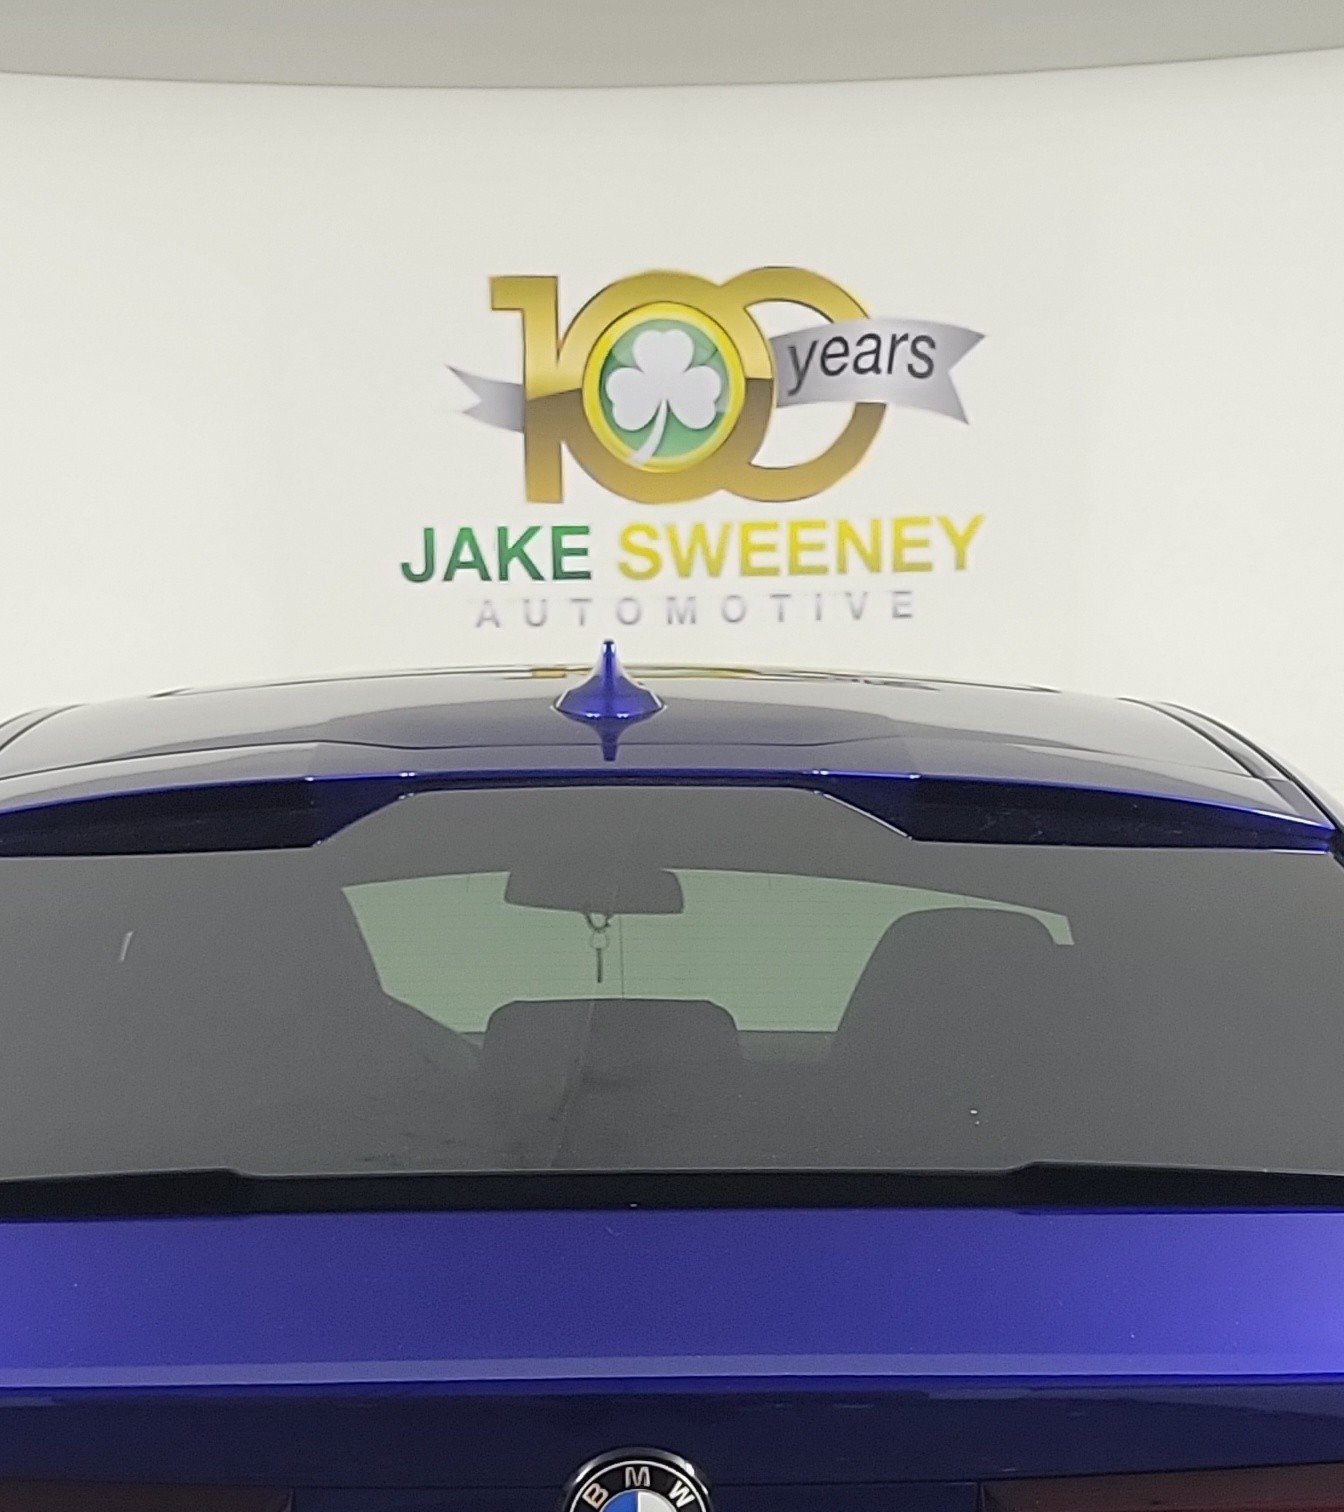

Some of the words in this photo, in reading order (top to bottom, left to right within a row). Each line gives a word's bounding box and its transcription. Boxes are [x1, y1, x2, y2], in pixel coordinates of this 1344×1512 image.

[490, 266, 887, 504] 100
[787, 332, 937, 396] years
[400, 524, 592, 584] JAKE
[617, 514, 986, 582] SWEENEY
[475, 591, 915, 629] AUTOMOTIVE
[582, 1466, 696, 1510] BMW
